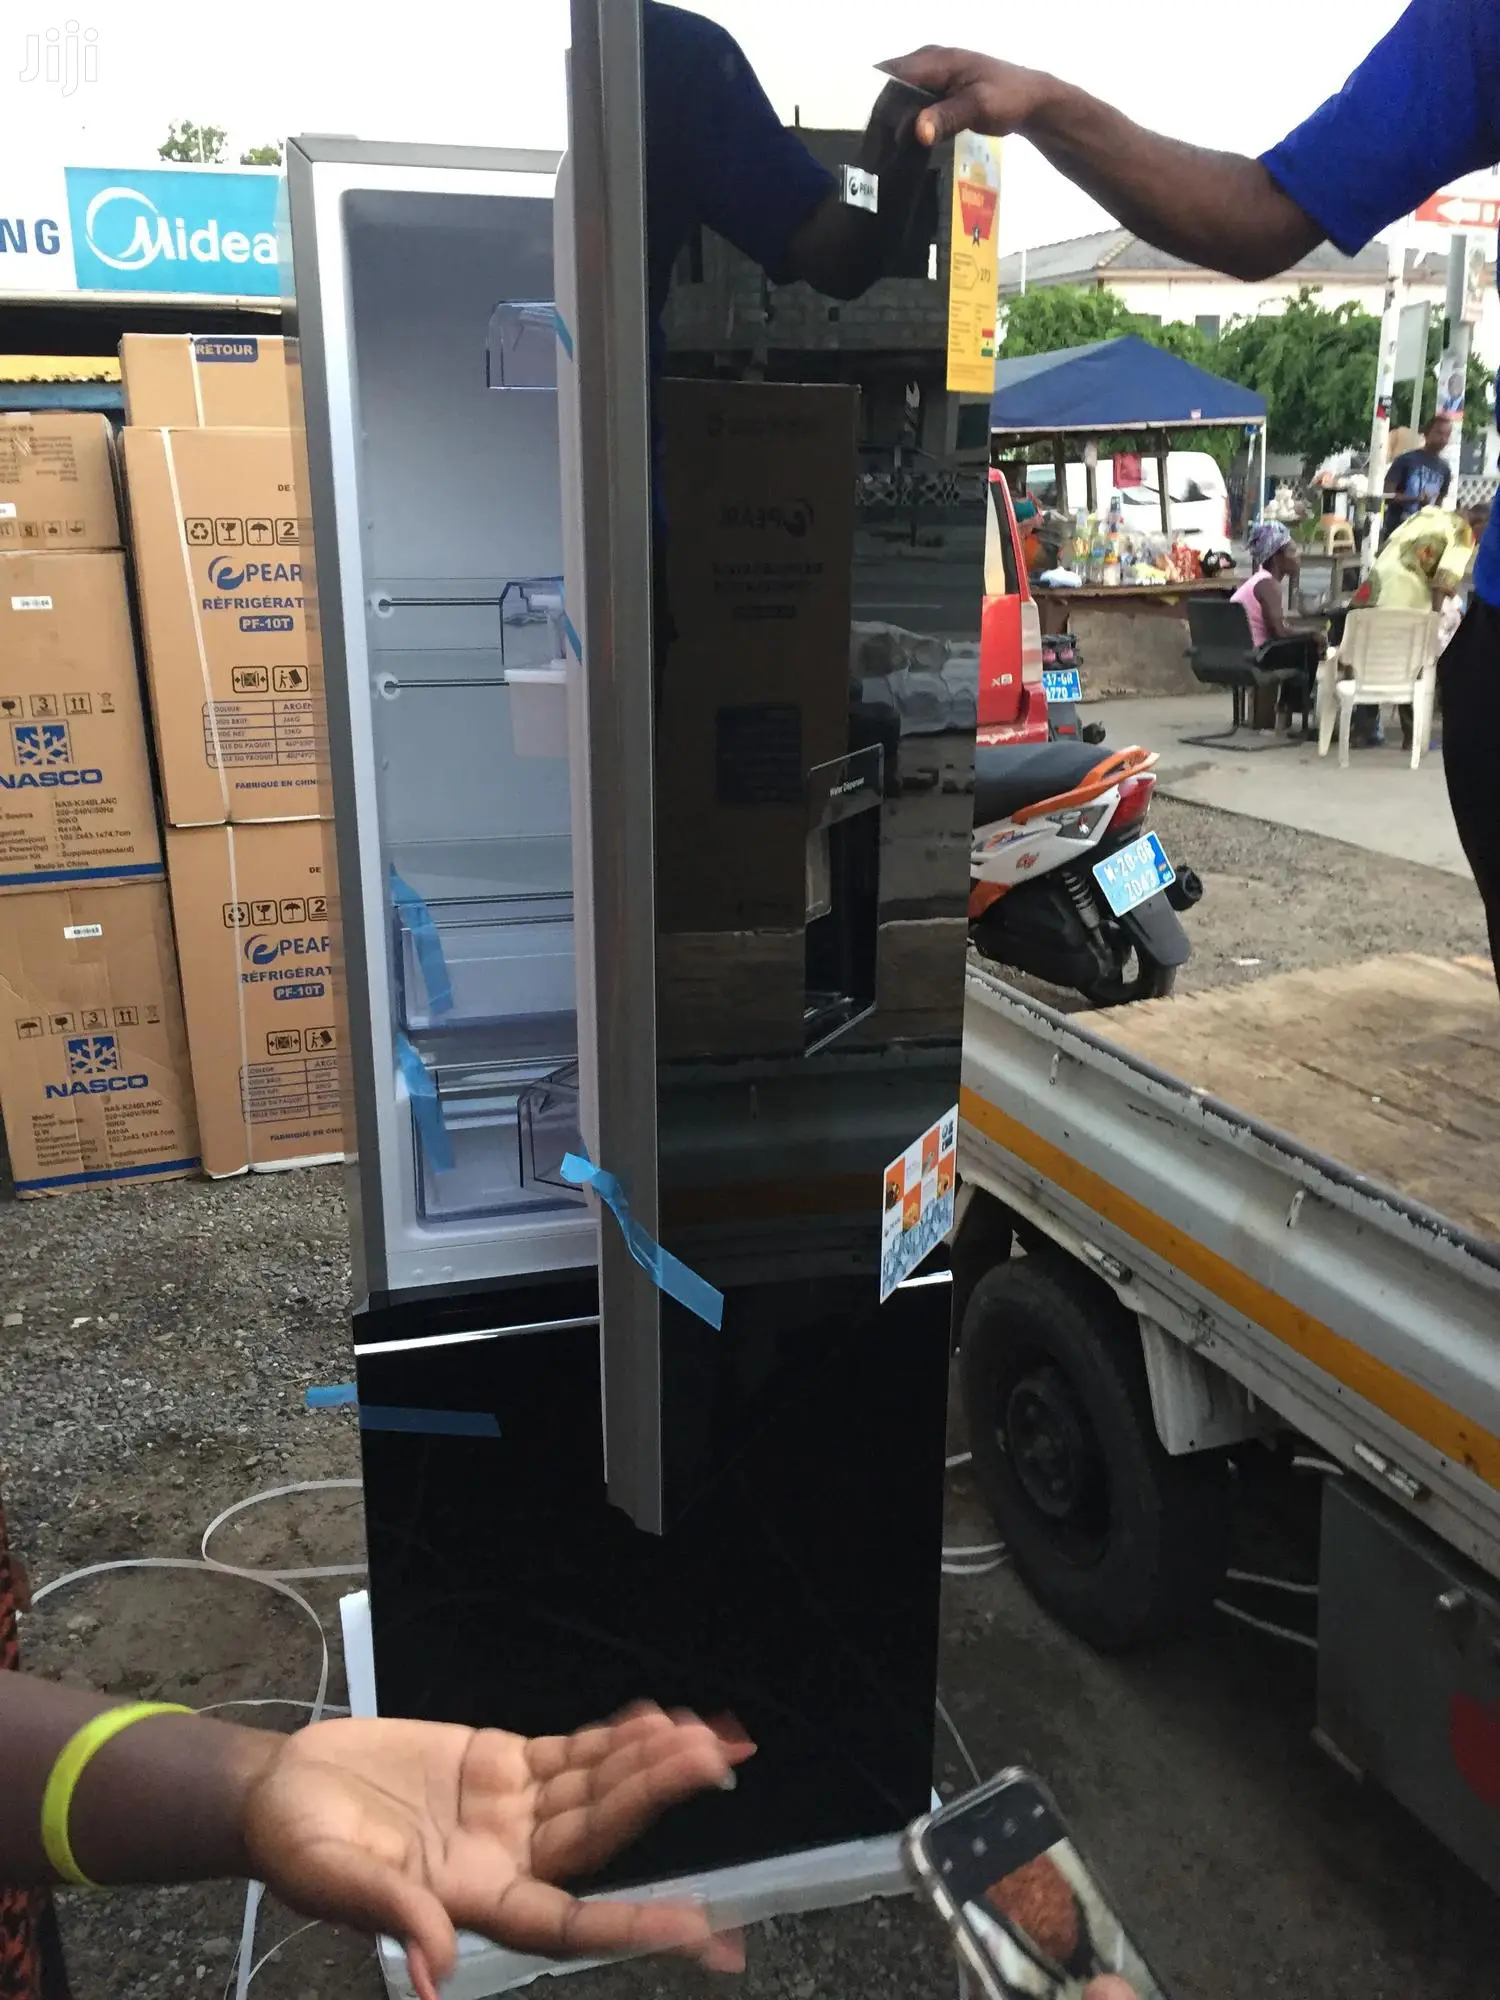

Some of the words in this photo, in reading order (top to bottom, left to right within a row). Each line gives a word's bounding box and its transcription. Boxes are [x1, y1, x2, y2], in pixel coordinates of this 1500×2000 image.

[117, 216, 280, 265] Midea
[195, 343, 254, 356] RETOUR
[283, 521, 295, 536] 2
[242, 617, 291, 630] PF-10T
[314, 900, 326, 912] 2
[276, 985, 322, 998] PF-10T
[89, 1011, 98, 1025] 3
[45, 1074, 149, 1098] NASCO
